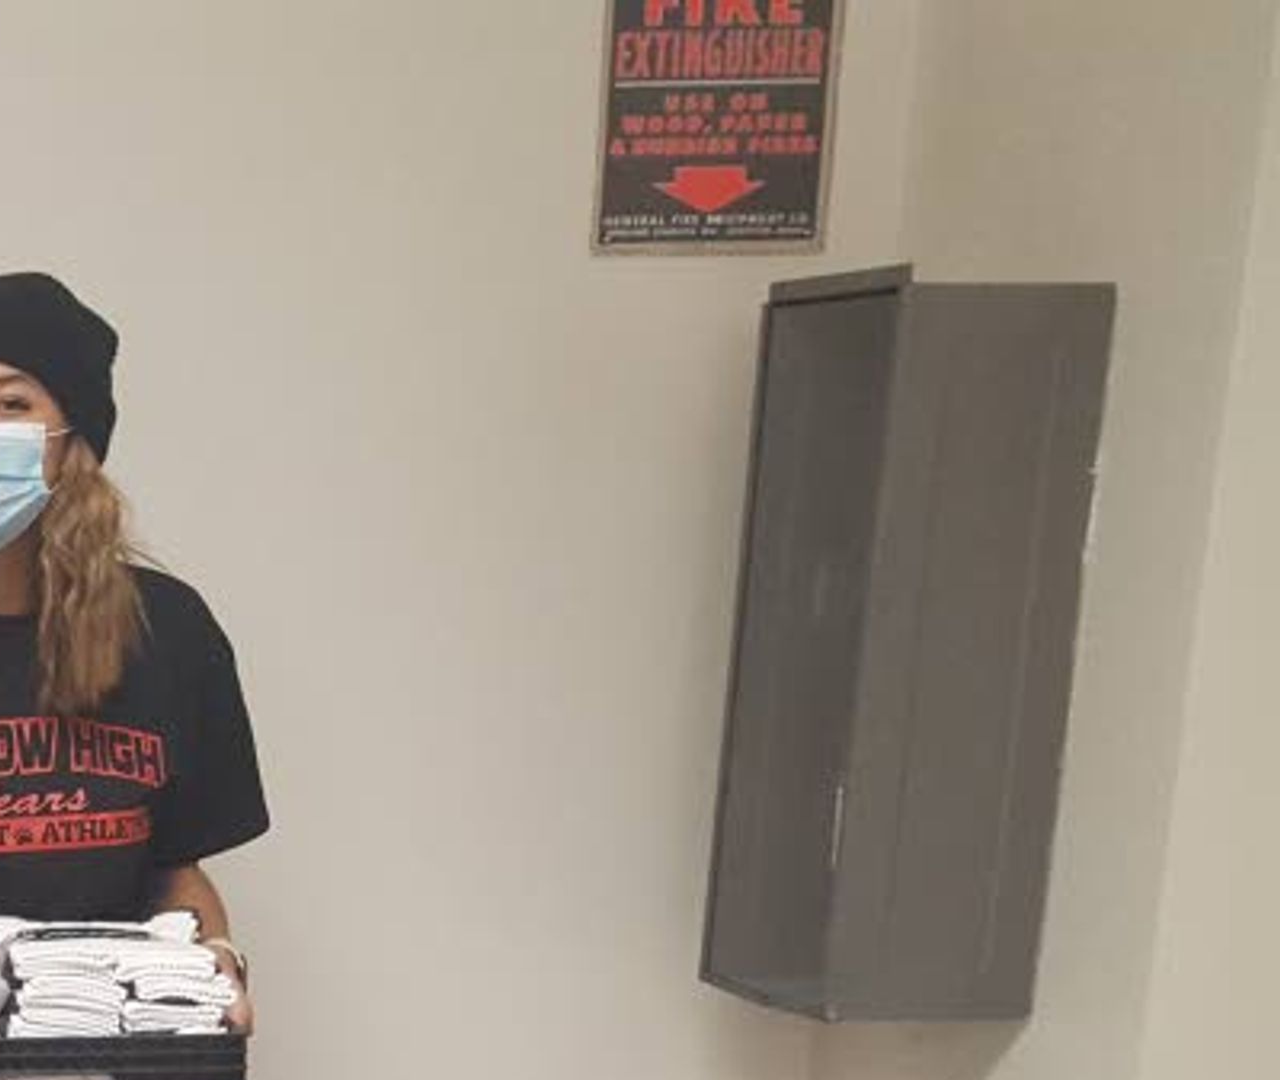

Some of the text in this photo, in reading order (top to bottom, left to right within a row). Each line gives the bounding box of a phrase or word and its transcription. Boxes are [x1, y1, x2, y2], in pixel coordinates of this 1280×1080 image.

[643, 0, 805, 26] FIRE
[616, 28, 824, 78] EXTINGUISHER
[666, 92, 769, 111] USE ON
[621, 113, 807, 134] WOOD, PAPER
[69, 721, 168, 788] HIGH
[41, 815, 140, 843] ATHLE
